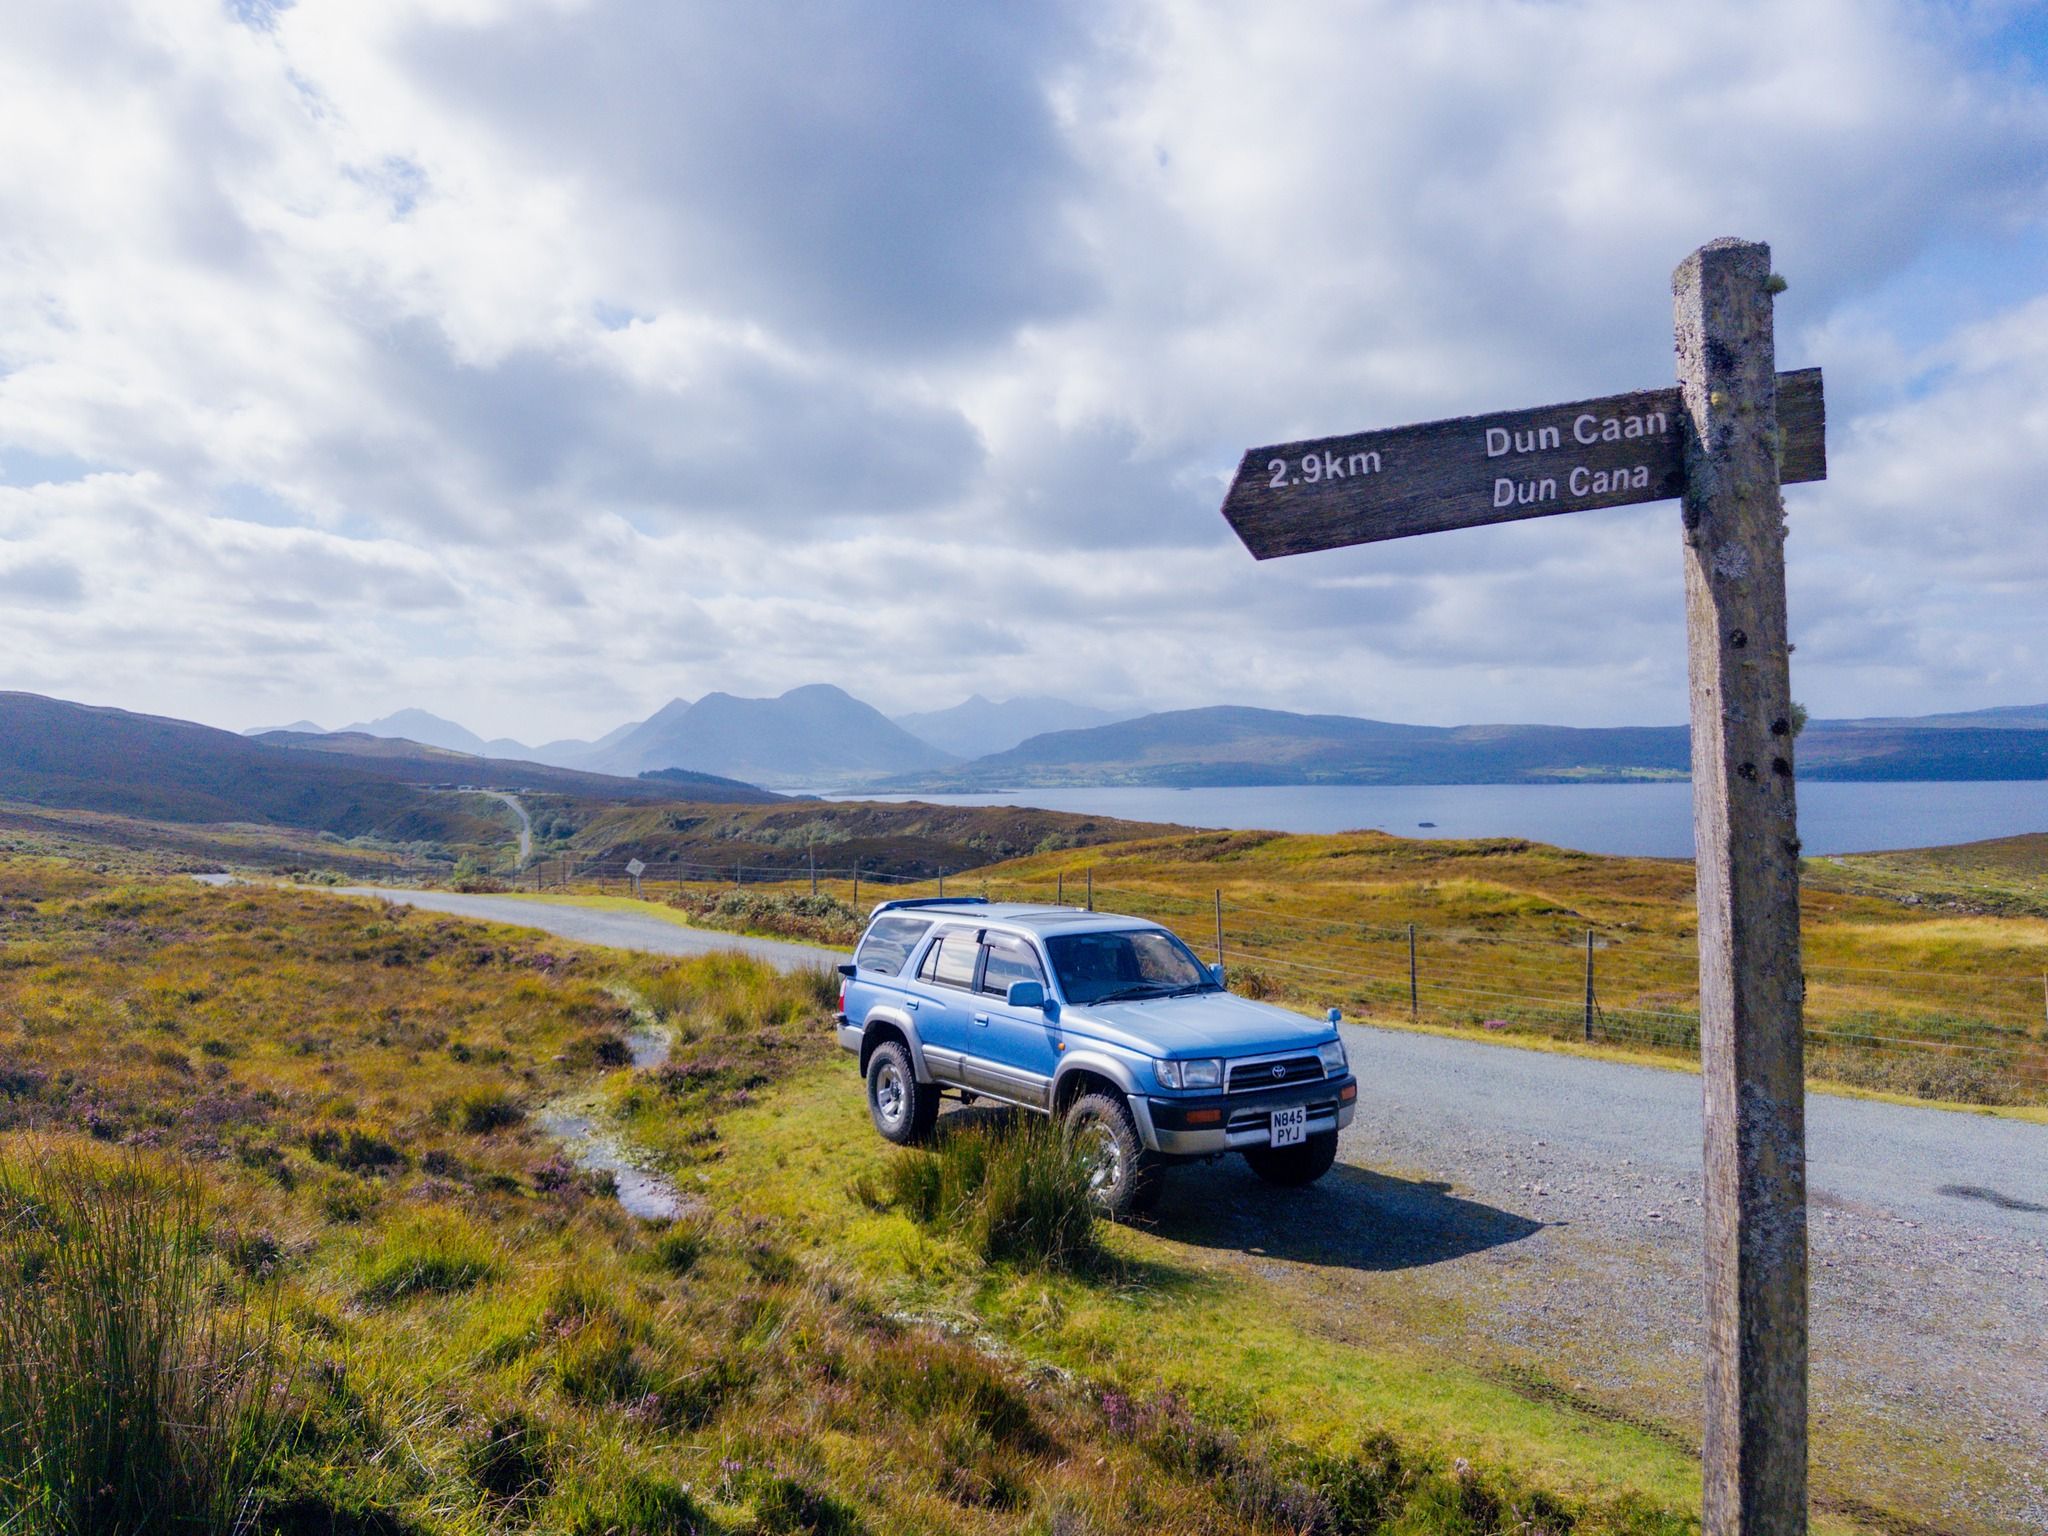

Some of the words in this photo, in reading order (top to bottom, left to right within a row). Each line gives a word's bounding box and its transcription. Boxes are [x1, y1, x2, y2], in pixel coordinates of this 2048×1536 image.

[1485, 426, 1560, 458] Dun
[1573, 412, 1667, 445] Caan
[1267, 450, 1381, 489] 2.9km
[1493, 477, 1557, 508] Dun
[1569, 465, 1648, 497] Cana
[1274, 1110, 1303, 1128] N845
[1277, 1127, 1300, 1143] PYJ
